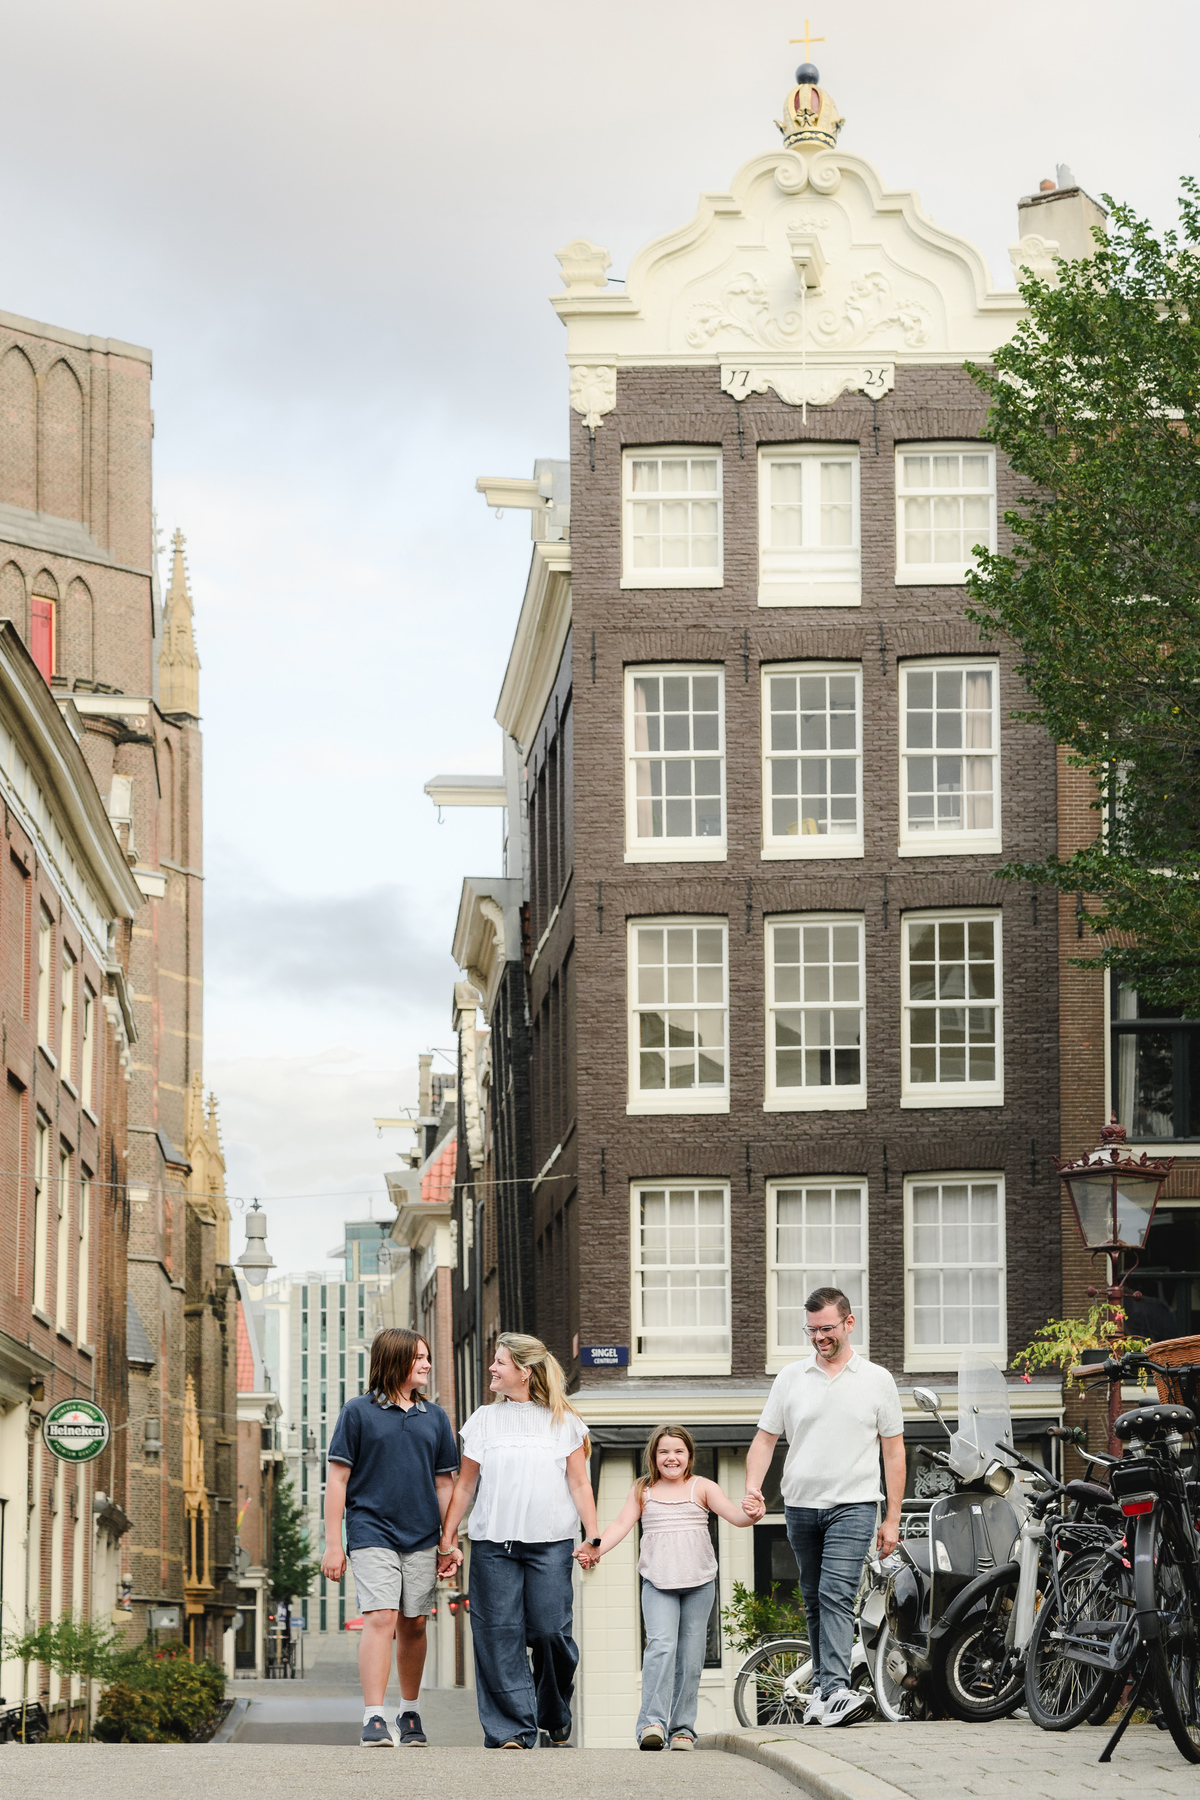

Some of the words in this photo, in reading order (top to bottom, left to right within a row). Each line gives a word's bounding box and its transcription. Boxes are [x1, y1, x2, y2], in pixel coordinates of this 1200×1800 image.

[727, 370, 750, 387] 17
[863, 369, 889, 387] 25
[591, 1348, 618, 1357] SINGEL
[50, 1425, 102, 1436] Heineken
[78, 1442, 98, 1457] QUALITY
